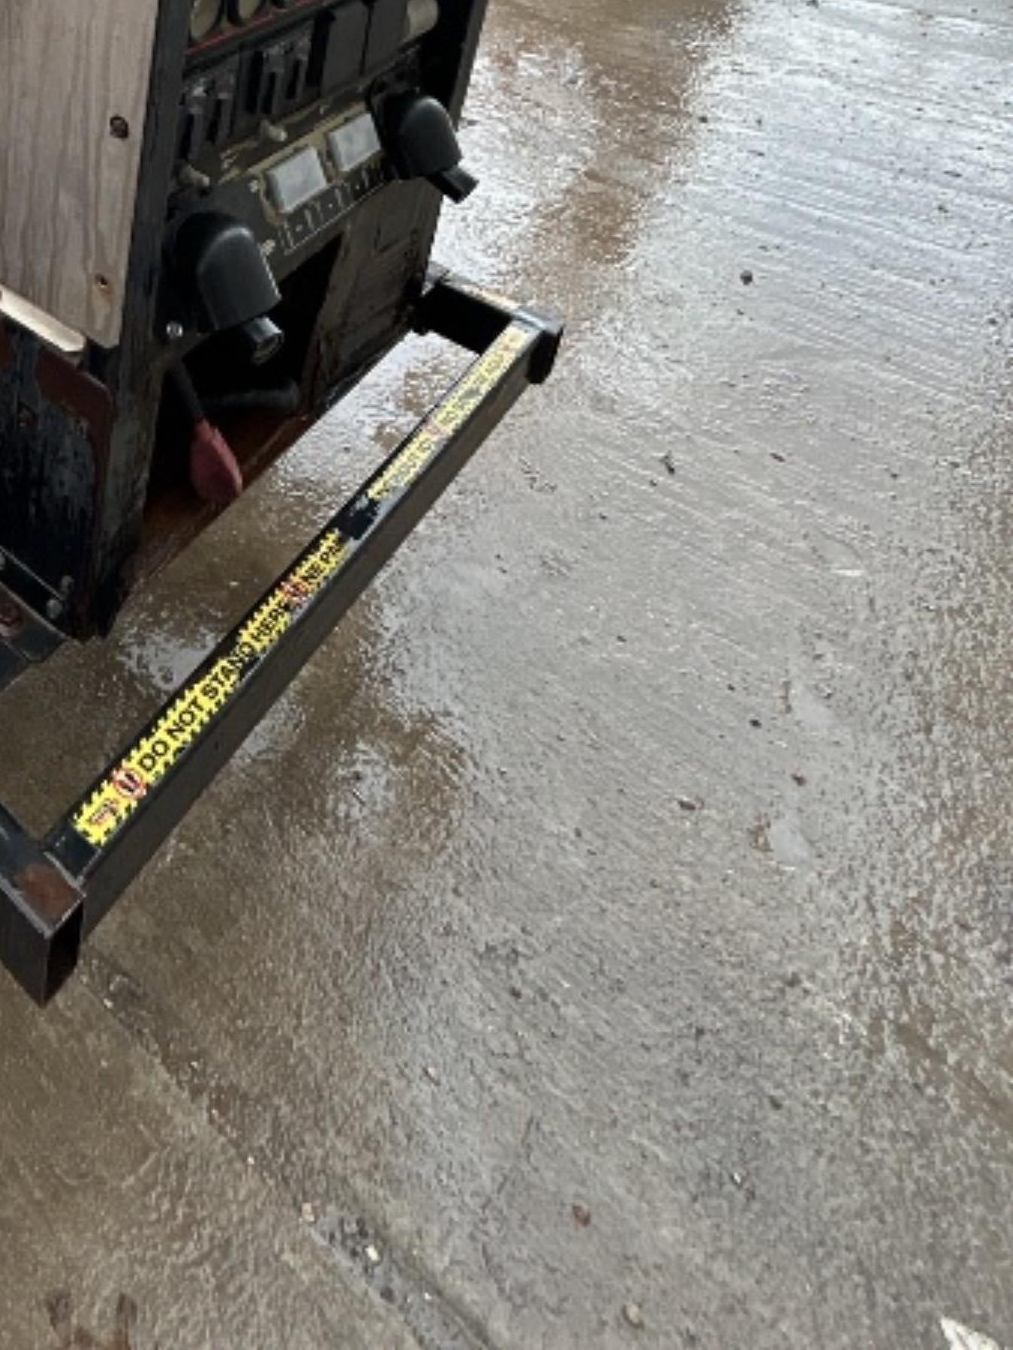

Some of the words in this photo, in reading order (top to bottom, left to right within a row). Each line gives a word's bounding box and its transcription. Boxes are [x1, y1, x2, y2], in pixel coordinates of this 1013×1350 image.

[138, 739, 169, 772] DO
[167, 699, 204, 741] NOT
[201, 640, 255, 700] STAND
